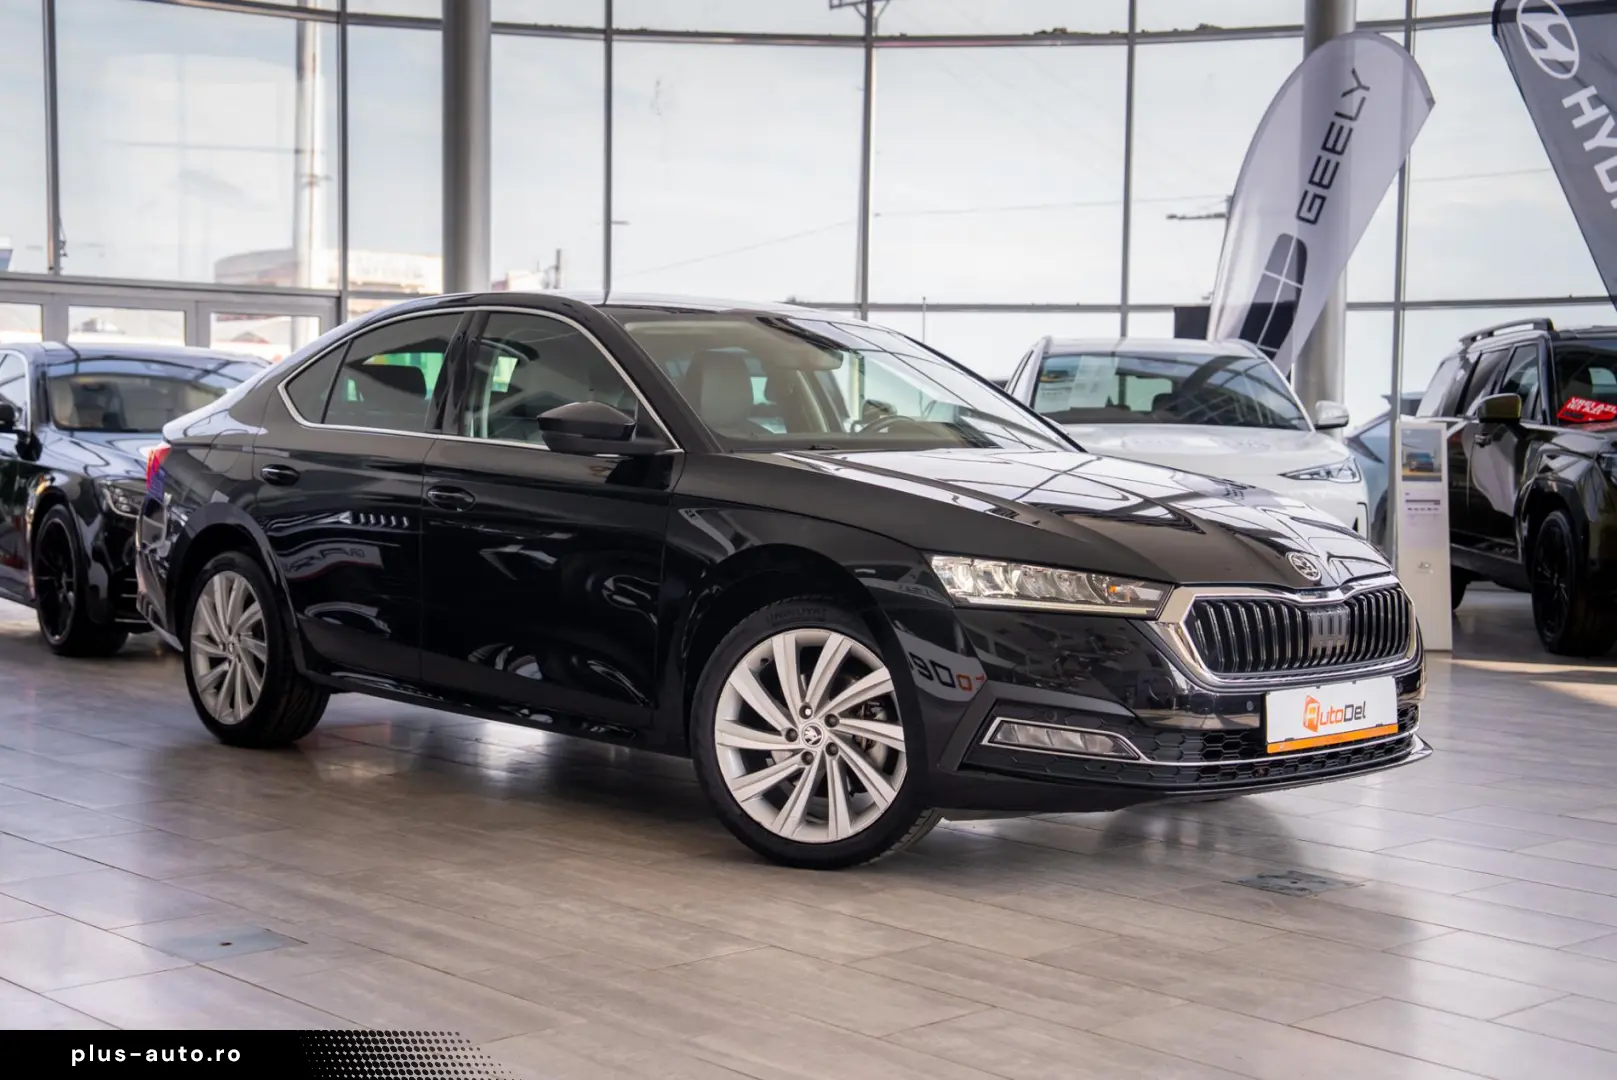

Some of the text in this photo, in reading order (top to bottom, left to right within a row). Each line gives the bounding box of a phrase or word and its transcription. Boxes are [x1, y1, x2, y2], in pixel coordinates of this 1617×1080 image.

[1295, 67, 1371, 226] GEELY
[1561, 84, 1617, 209] HYU
[1303, 696, 1367, 731] AutoDel
